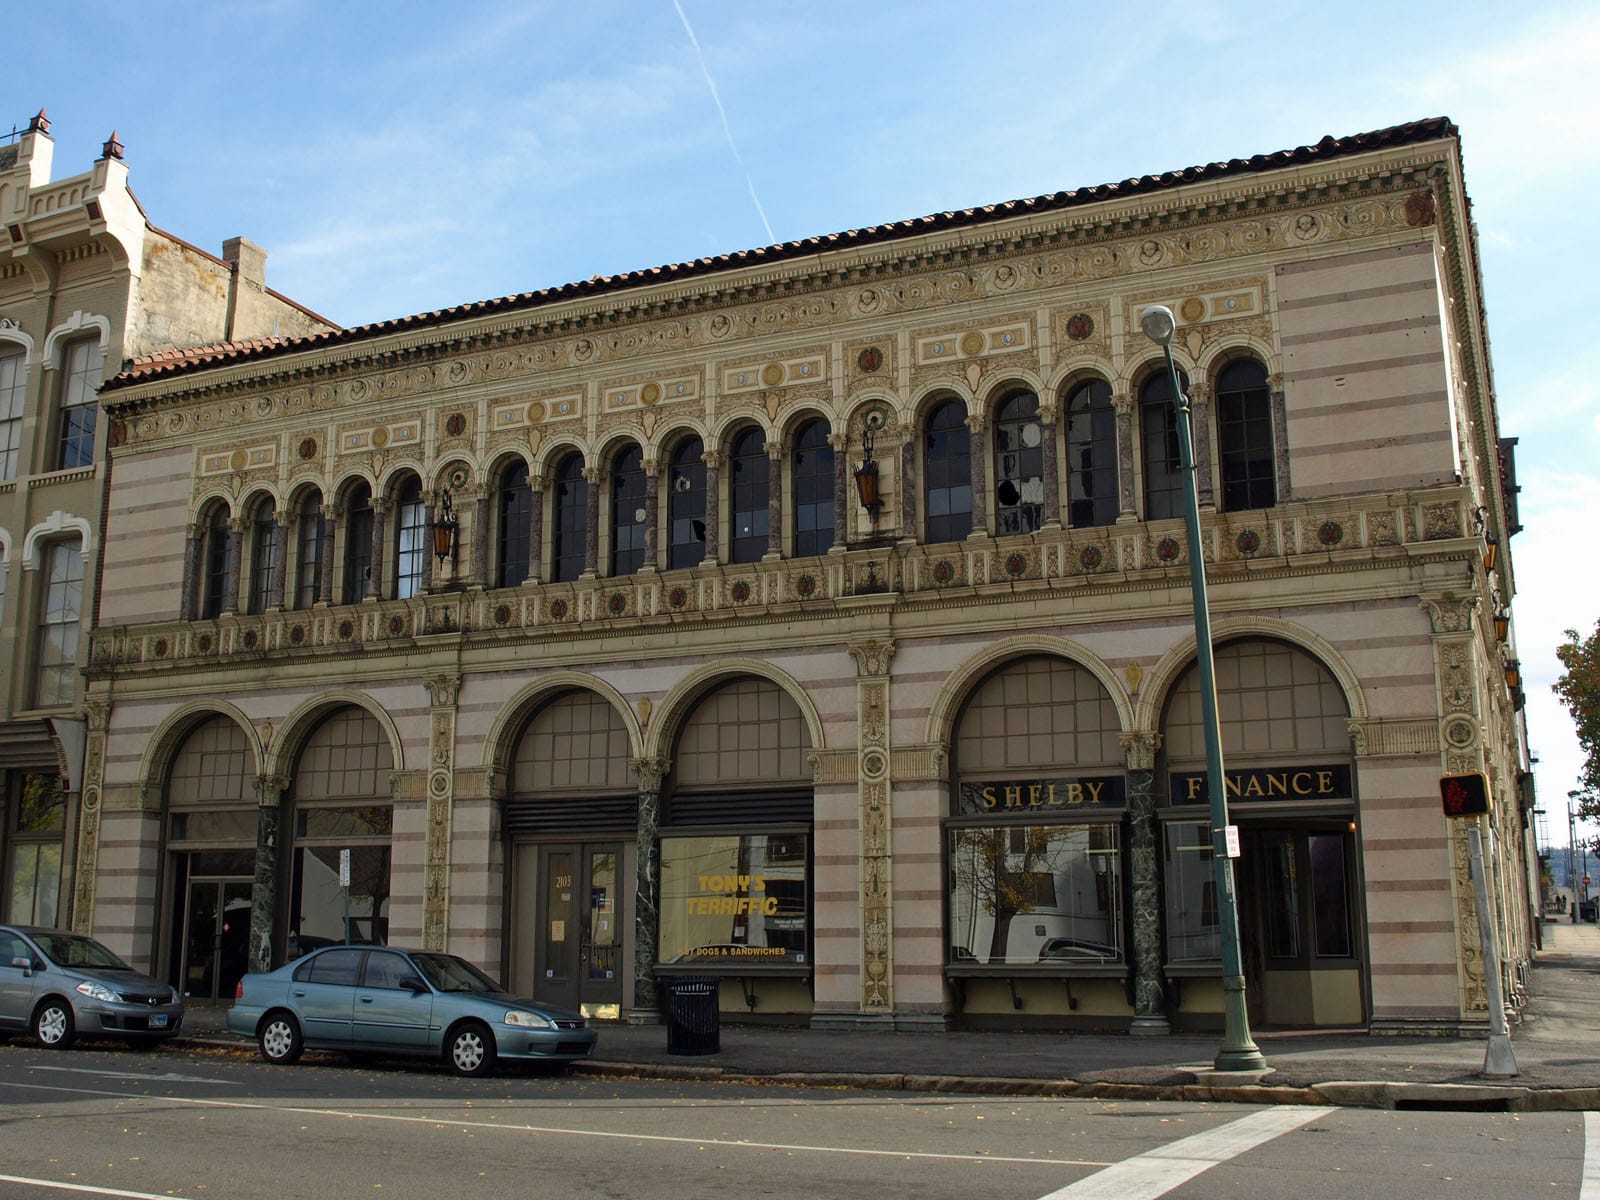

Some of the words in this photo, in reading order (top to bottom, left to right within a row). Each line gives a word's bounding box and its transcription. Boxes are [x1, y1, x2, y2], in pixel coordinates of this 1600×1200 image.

[982, 782, 1105, 808] SHELBY
[1186, 771, 1335, 799] FNANCE
[555, 875, 572, 889] 2103
[698, 874, 767, 892] TONY'S
[687, 896, 778, 915] TERRIFFIC
[696, 947, 720, 956] DOGS
[721, 948, 728, 956] &
[730, 947, 786, 956] SANDWICHES
